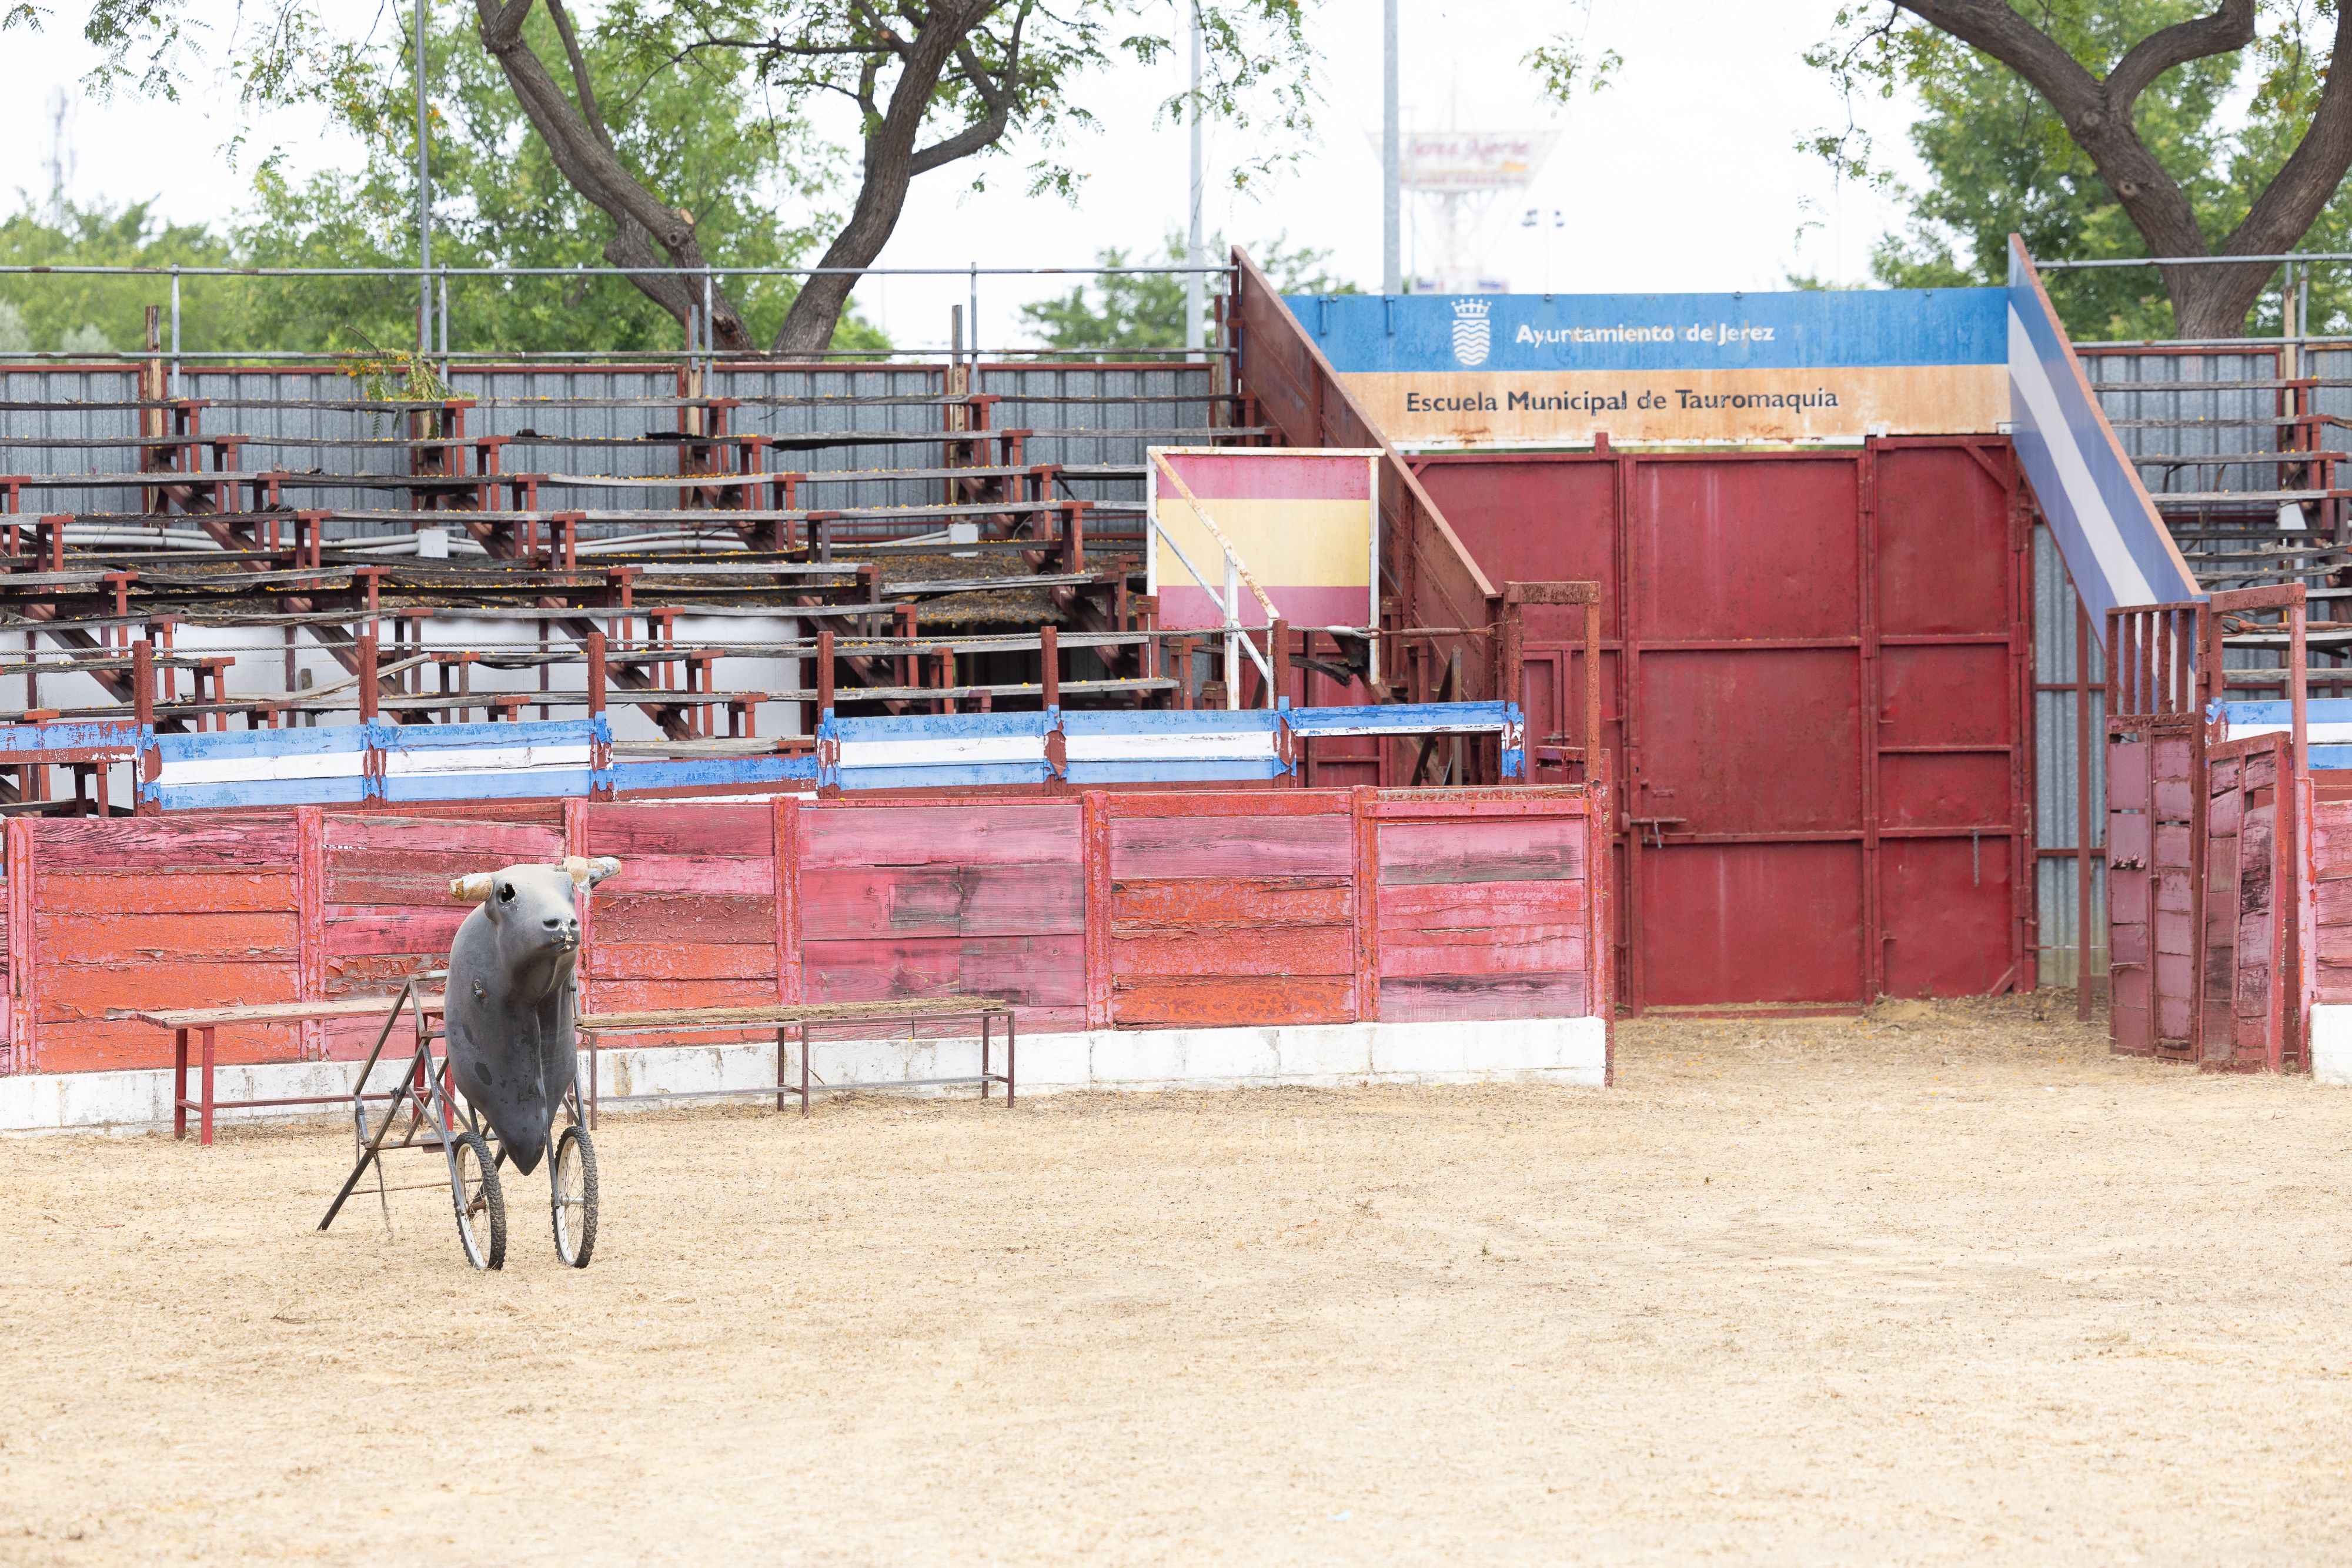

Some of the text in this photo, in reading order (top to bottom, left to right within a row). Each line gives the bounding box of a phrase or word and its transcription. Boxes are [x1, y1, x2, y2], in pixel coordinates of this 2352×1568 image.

[1515, 323, 1775, 348] Ayuntamiento de Jerez
[1407, 387, 1839, 416] Escuela Municipal de Tauromaquia
